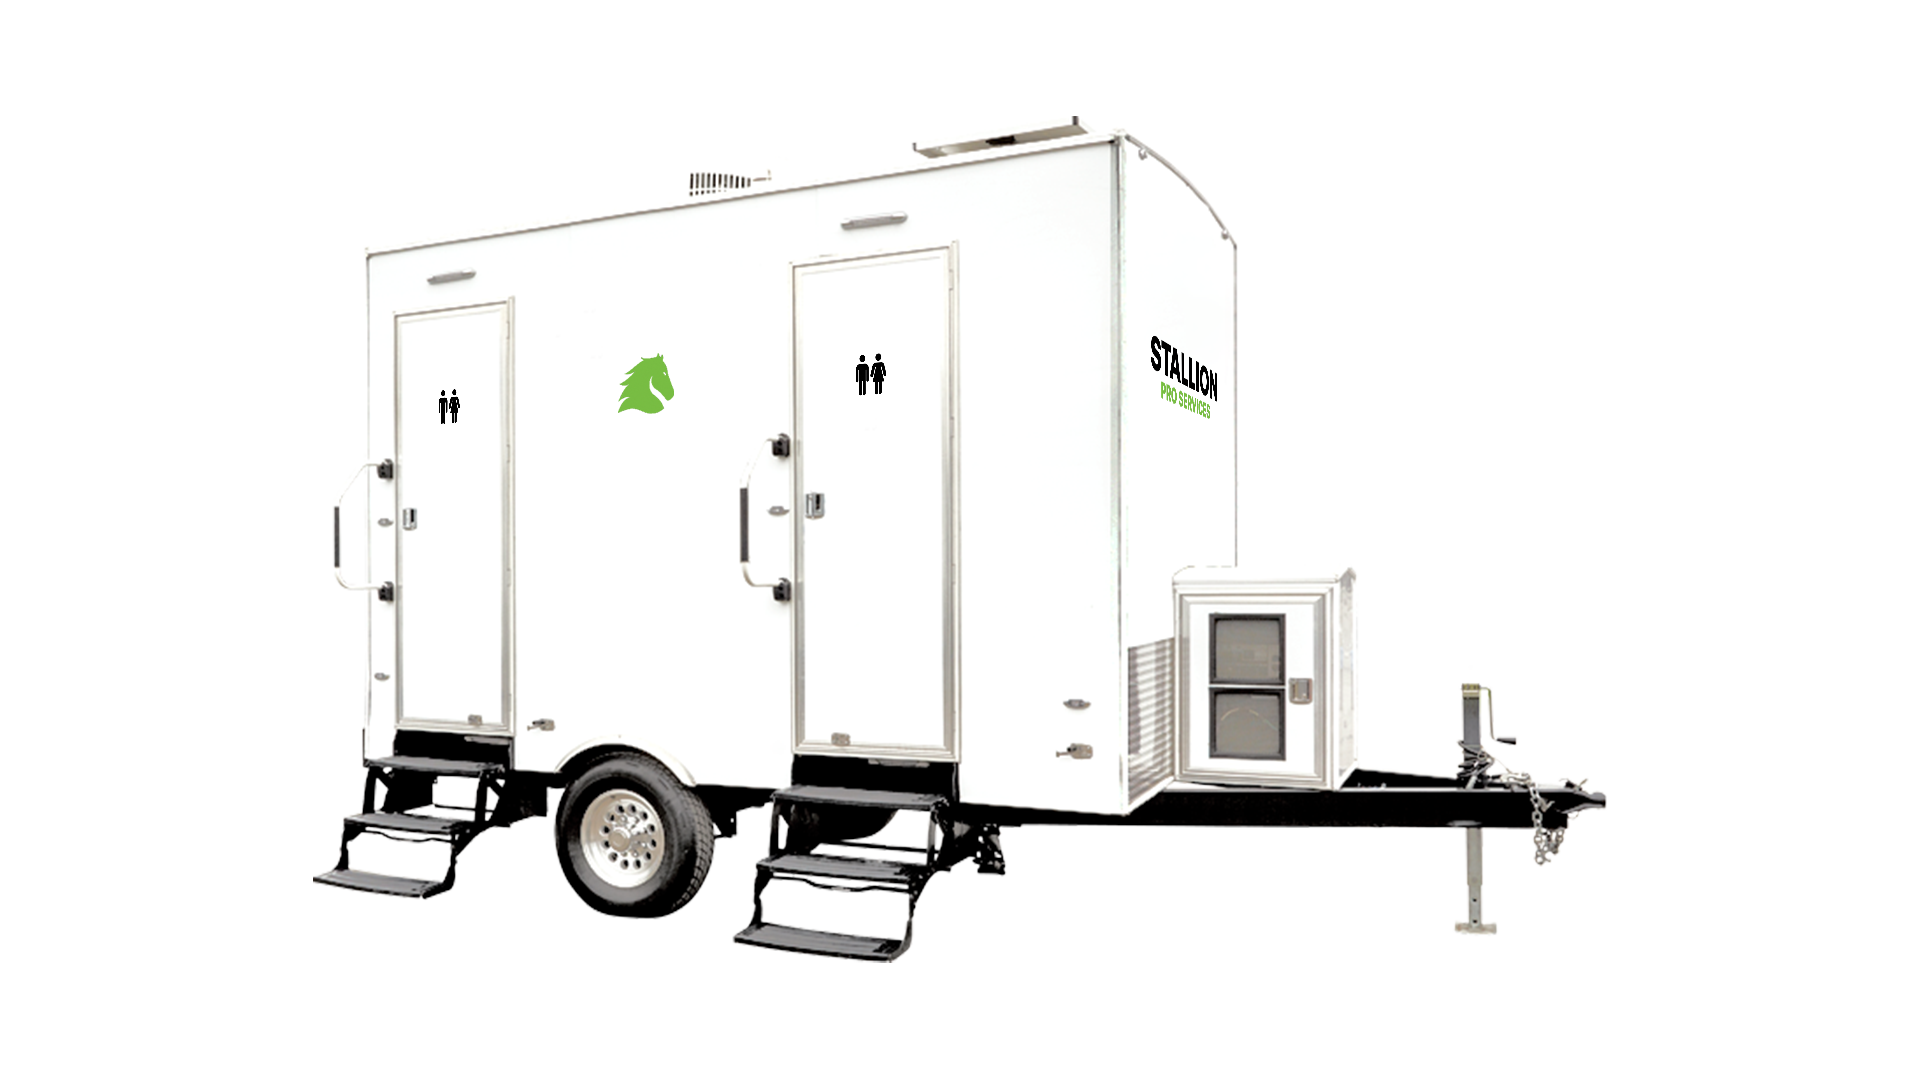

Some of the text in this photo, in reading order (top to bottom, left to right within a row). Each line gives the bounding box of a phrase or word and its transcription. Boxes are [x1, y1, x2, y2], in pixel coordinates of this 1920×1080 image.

[1151, 336, 1217, 402] STALLION
[1161, 381, 1210, 419] PRO SERVICES
